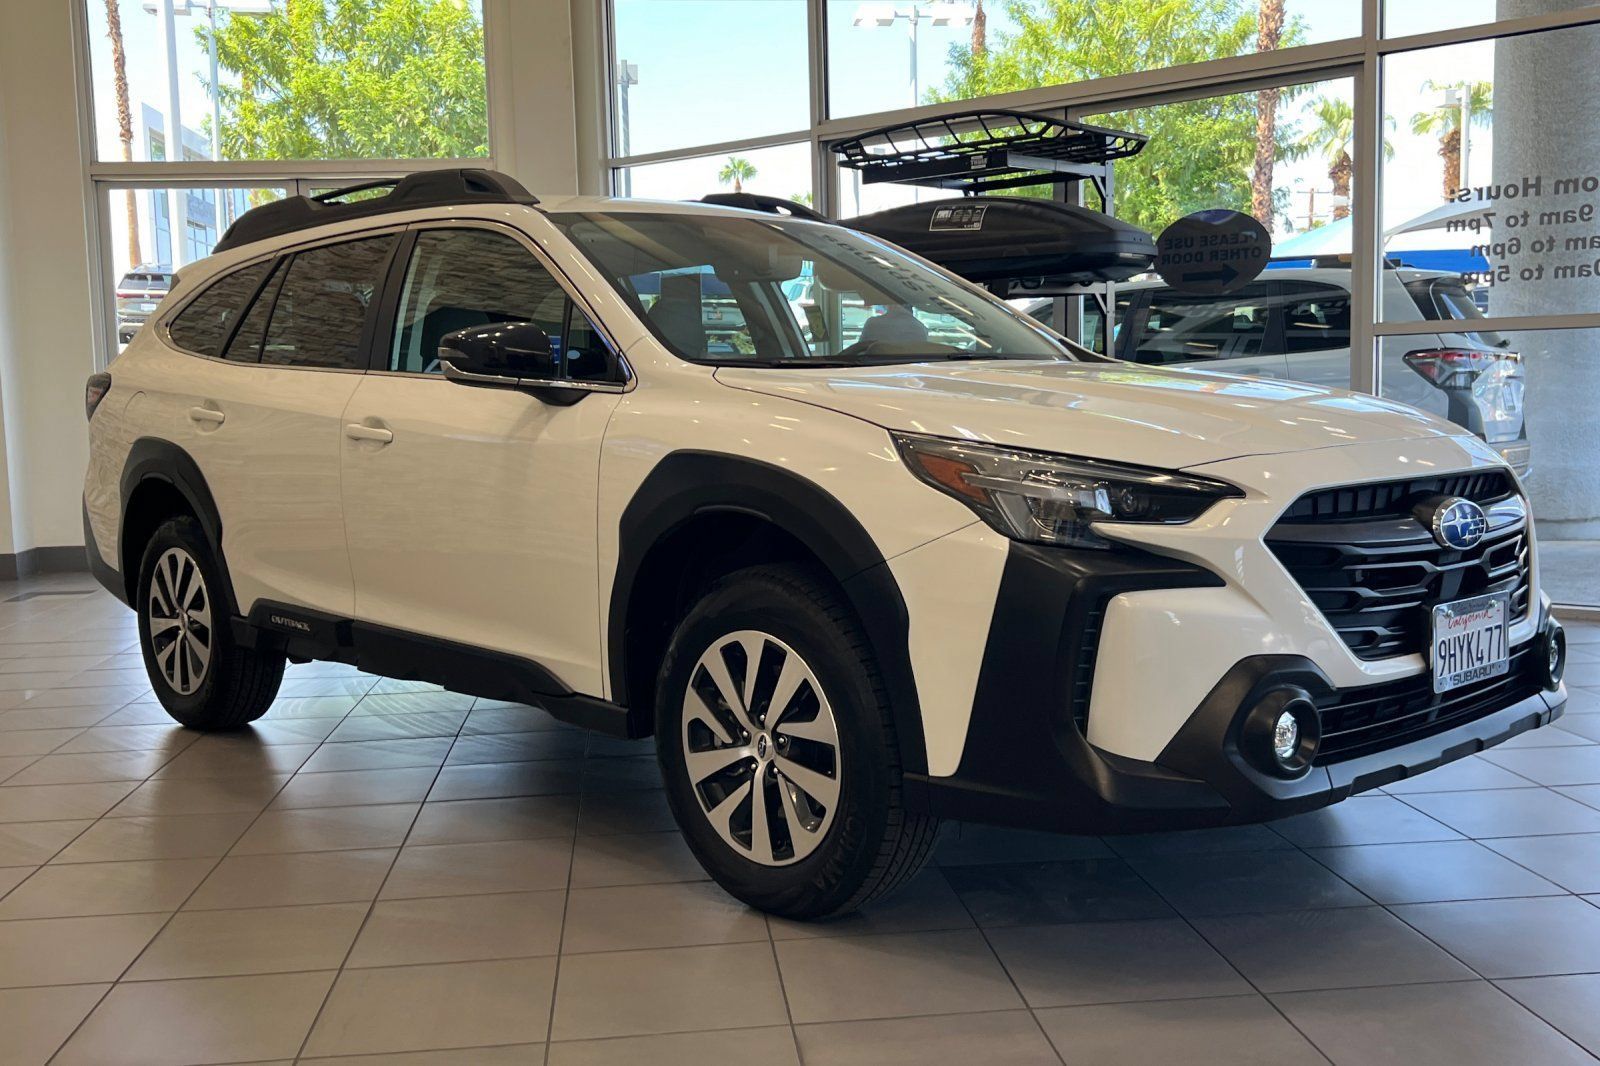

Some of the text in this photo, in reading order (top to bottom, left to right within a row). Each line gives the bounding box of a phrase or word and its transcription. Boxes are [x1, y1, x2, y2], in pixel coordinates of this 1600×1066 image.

[271, 615, 311, 632] OUTBACK
[1438, 624, 1503, 677] 9HYK477
[1453, 666, 1492, 686] SUBARU
